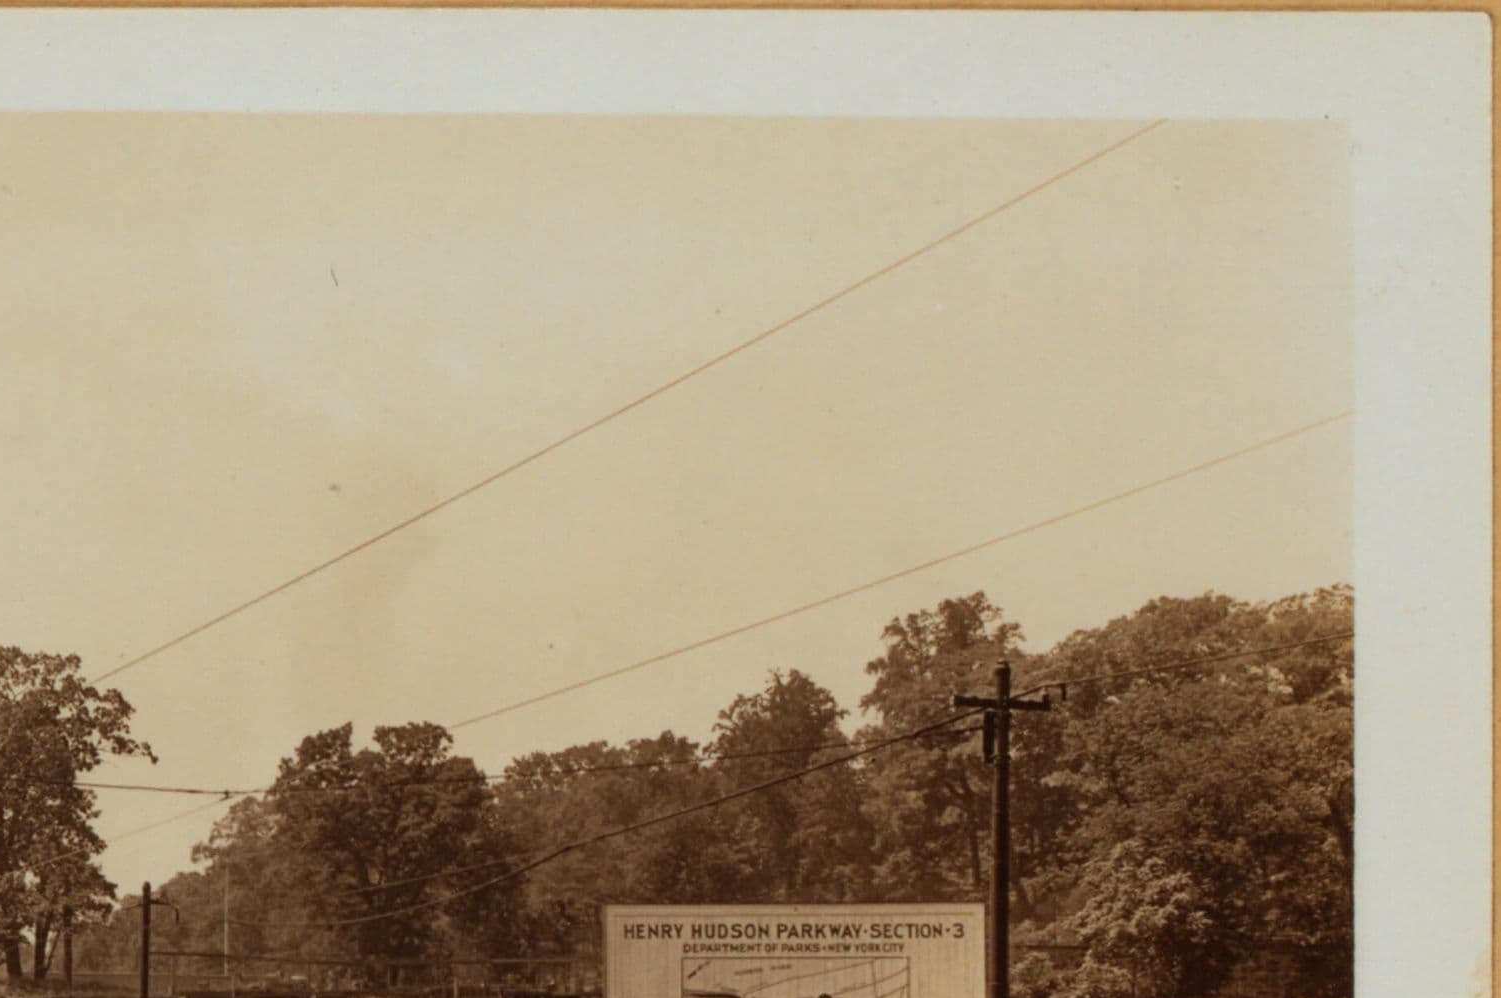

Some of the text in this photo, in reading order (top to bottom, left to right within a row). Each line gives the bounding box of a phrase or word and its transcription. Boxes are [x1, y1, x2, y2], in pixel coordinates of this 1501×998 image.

[623, 922, 684, 940] HENRY
[690, 922, 771, 940] HUDSON
[683, 941, 762, 954] DEPARTMENT
[764, 941, 779, 954] OF
[854, 941, 881, 954] YORK
[882, 941, 905, 954] CITY
